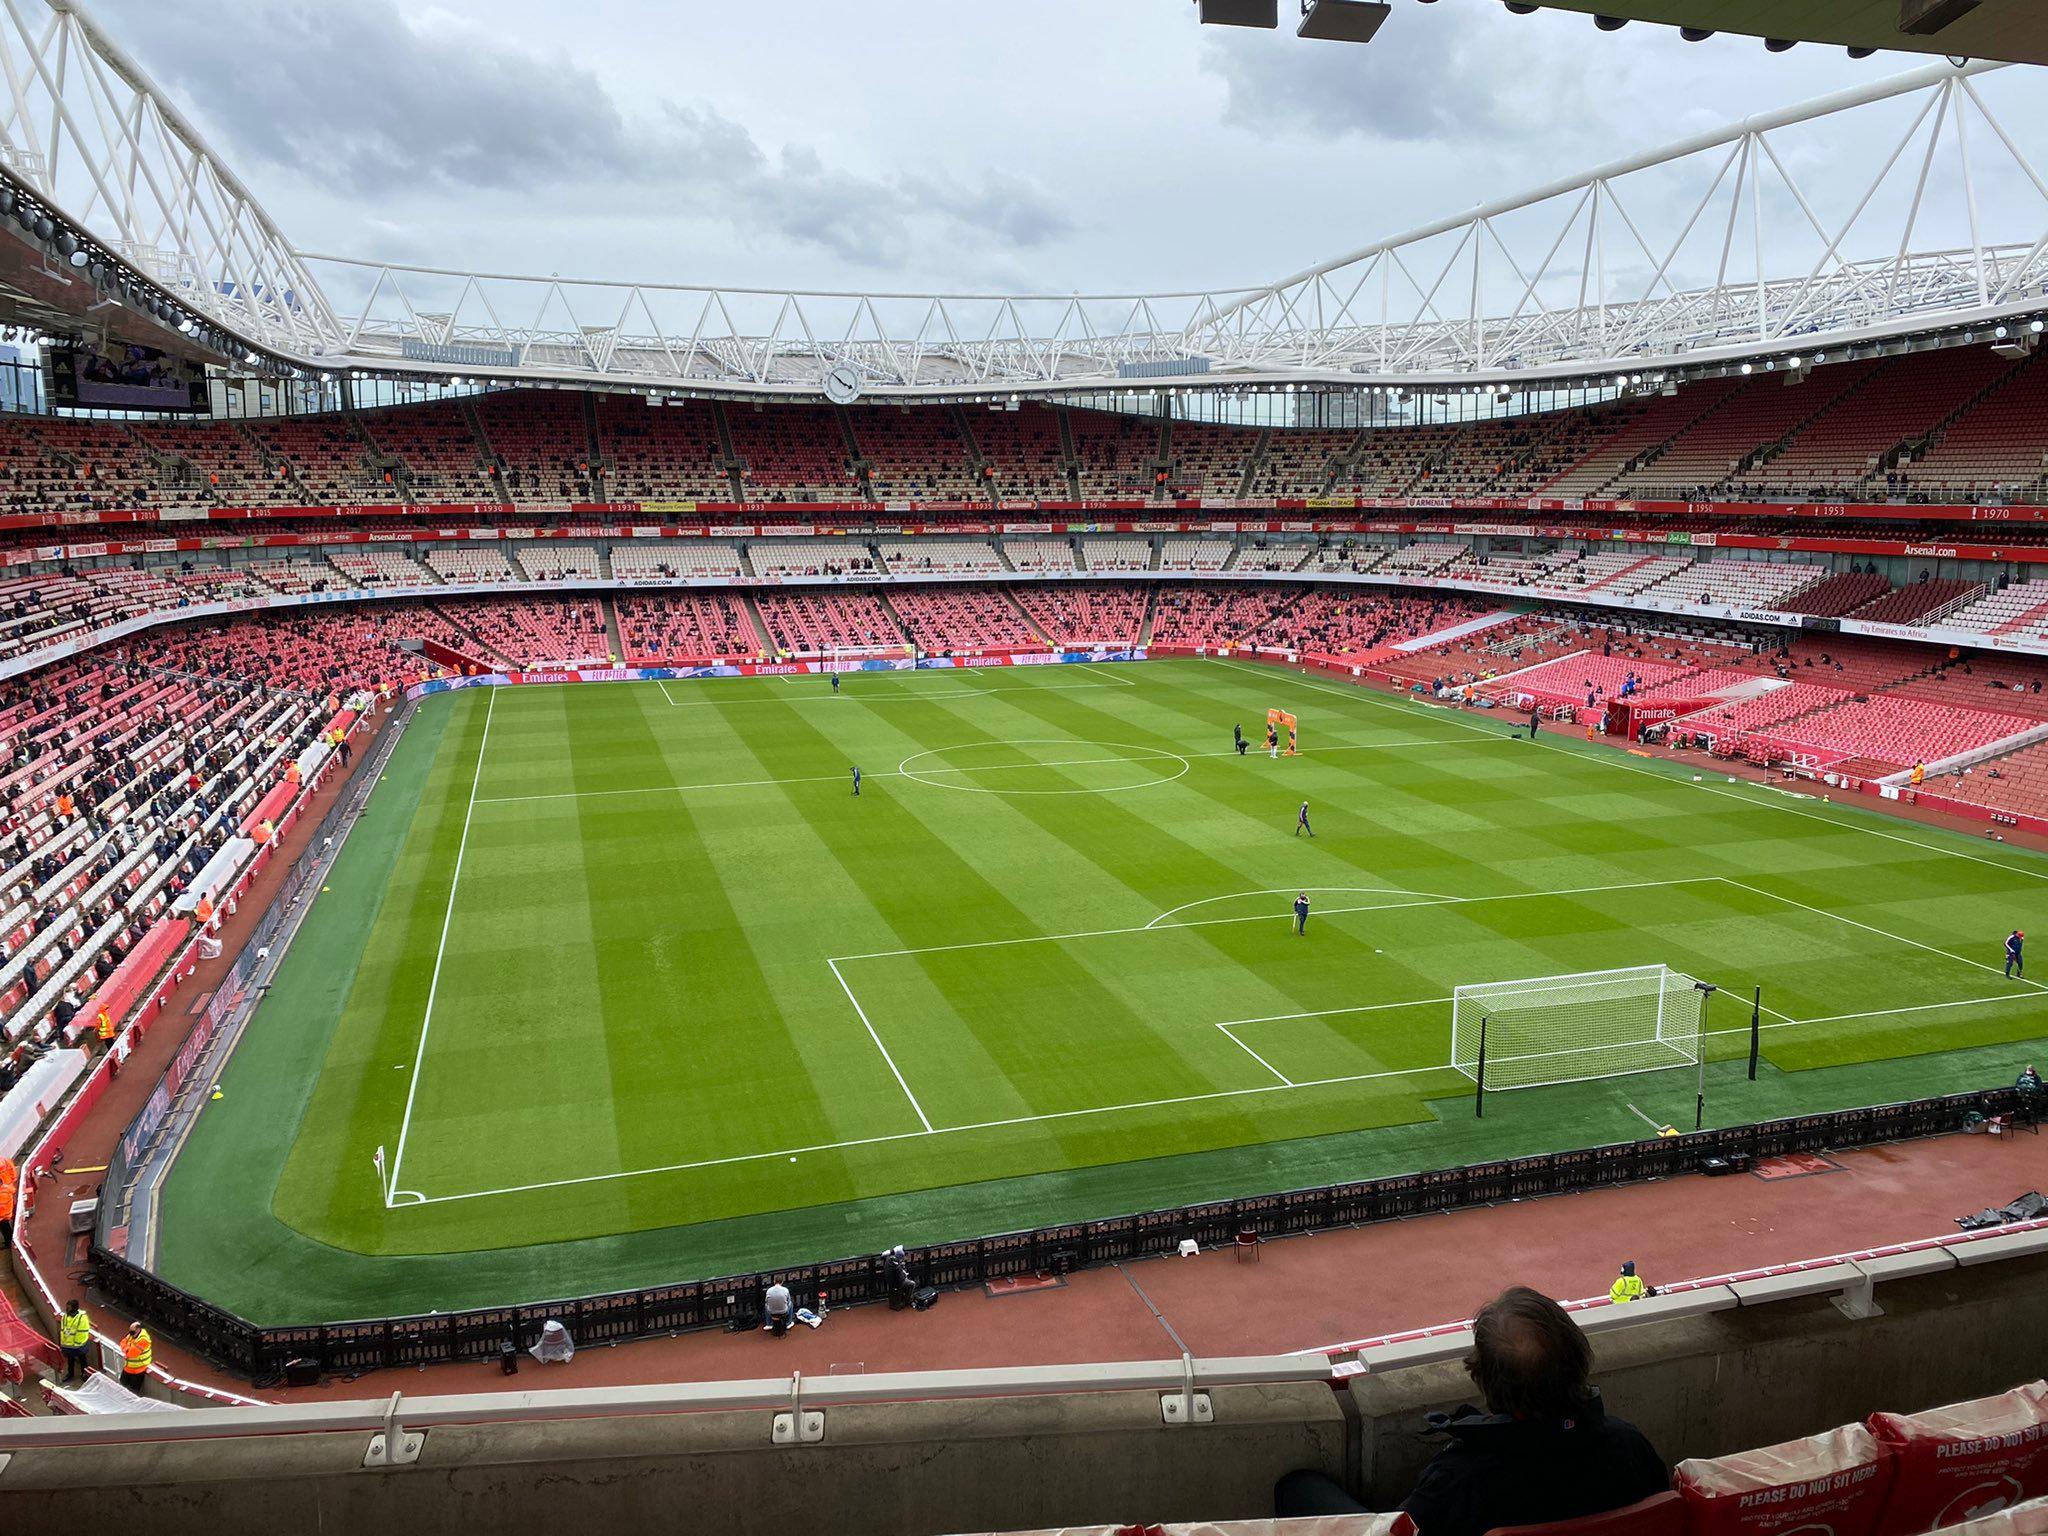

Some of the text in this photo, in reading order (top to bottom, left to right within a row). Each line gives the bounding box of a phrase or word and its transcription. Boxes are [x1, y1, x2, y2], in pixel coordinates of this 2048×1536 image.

[1415, 499, 1444, 507] ARMENIA
[345, 507, 362, 515] 2017
[1696, 504, 1713, 512] 1950
[1823, 507, 1845, 516] 1953
[1983, 508, 2010, 519] 1970
[922, 526, 959, 534] Arsenal.com
[1188, 523, 1211, 532] Arsenal
[1242, 523, 1266, 531] ROCKY
[1415, 525, 1449, 533] Arsenal.com
[570, 528, 591, 537] HONG
[677, 528, 702, 536] Arsenal
[721, 528, 753, 536] Slovenia
[368, 533, 412, 542] Arsenal.com
[1646, 532, 1668, 542] Arsenal
[121, 543, 145, 553] Arsenal
[1904, 545, 1957, 558] Arsenal.com
[1740, 611, 1780, 623] ADIDAS.COM
[1860, 625, 1928, 639] Fly Emirates to Africa
[964, 656, 1003, 667] Emirates
[755, 664, 798, 674] Emirates
[522, 672, 568, 684] Emirates
[1634, 707, 1676, 720] Emirates
[1936, 1425, 2040, 1458] PLEASE DO NOT SIT
[1739, 1487, 1787, 1508] PLEASE
[1789, 1484, 1806, 1500] DO
[1809, 1477, 1831, 1496] NOT
[1834, 1474, 1850, 1489] SIT
[1851, 1465, 1878, 1484] HERE
